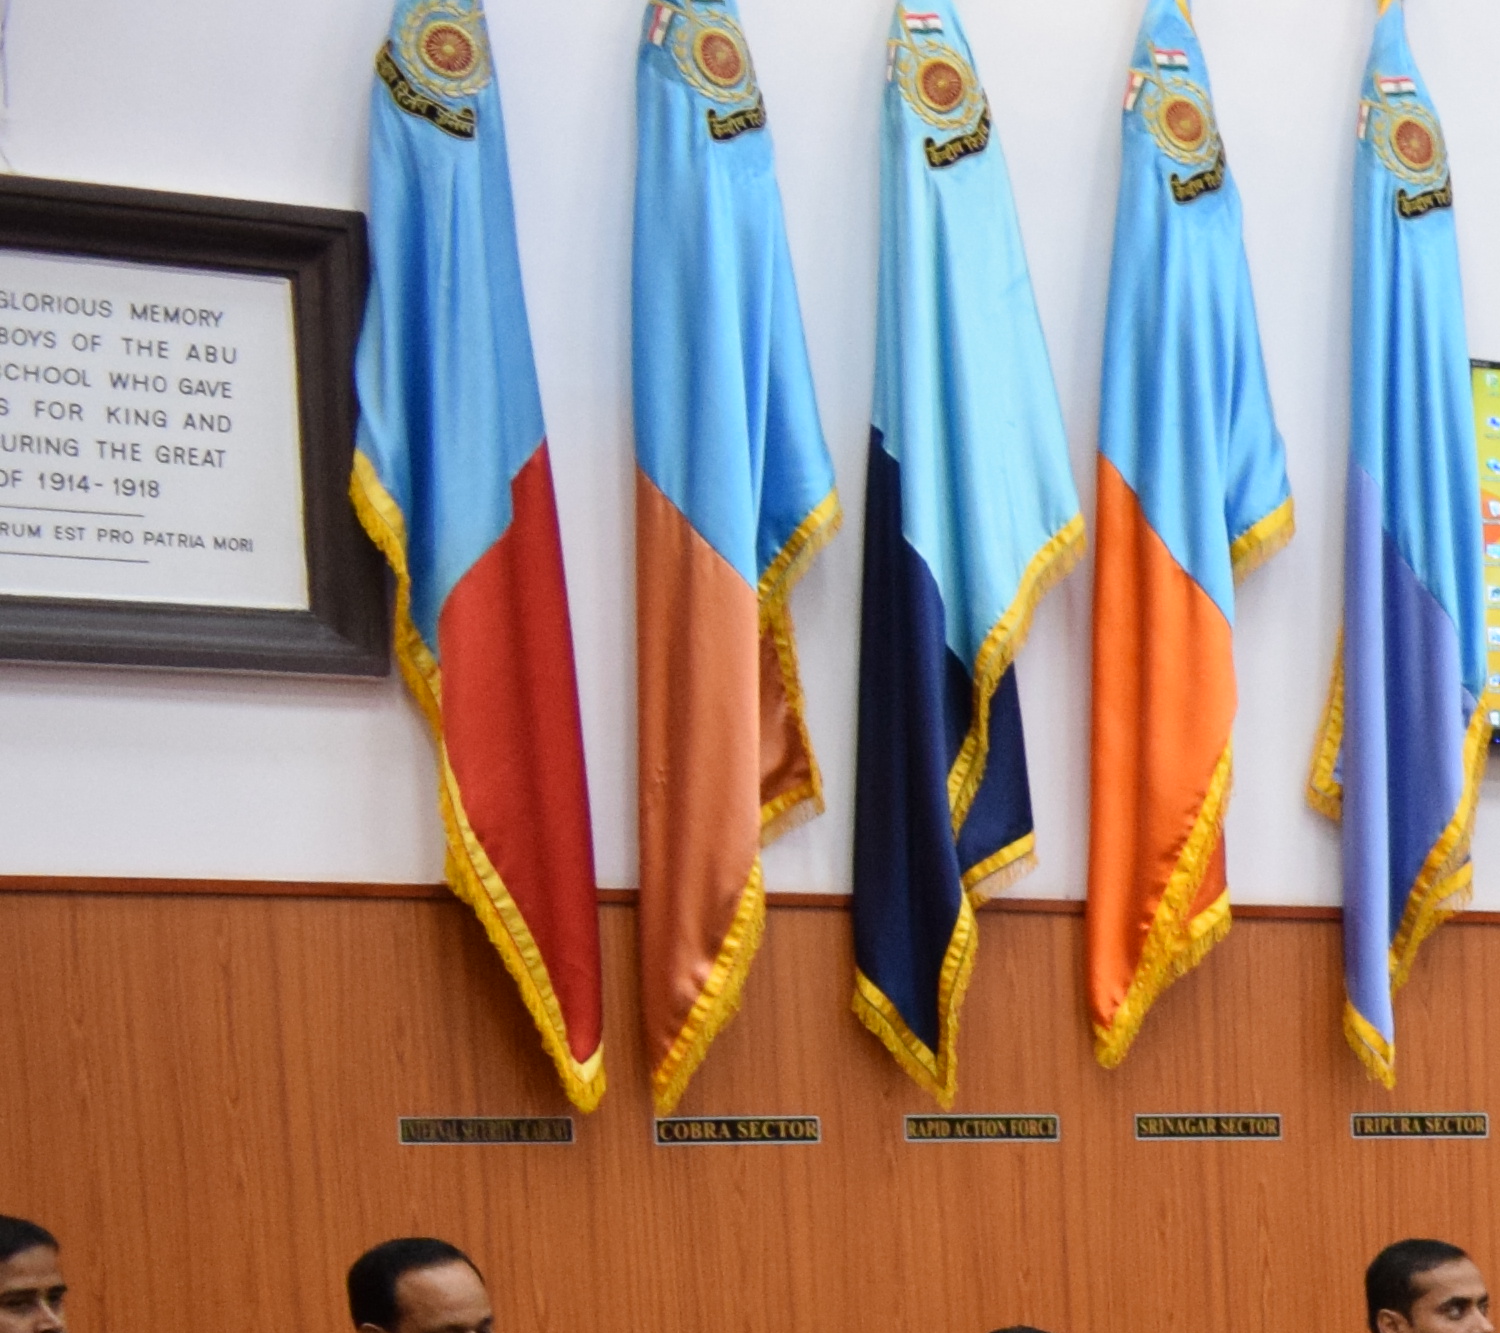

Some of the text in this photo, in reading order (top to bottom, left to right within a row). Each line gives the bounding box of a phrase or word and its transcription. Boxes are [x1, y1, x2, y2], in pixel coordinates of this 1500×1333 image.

[129, 303, 224, 328] MEMORY
[71, 333, 103, 353] OF
[121, 336, 170, 360] THE
[185, 344, 238, 365] ABU
[0, 362, 233, 400] CHOOL WHO GAVE
[33, 399, 85, 423] FOR
[106, 405, 169, 429] KING
[182, 412, 233, 434] AND
[0, 434, 228, 469] URING THE GREAT
[53, 525, 255, 553] EST PRO PATRIA MORI
[659, 1119, 818, 1141] COBRA SECTOR
[908, 1118, 1057, 1138] RAPID ACTION FORCE
[1139, 1117, 1279, 1136] SRINAGAR SECTOR
[1353, 1116, 1487, 1135] TRIPURA SECTOR
